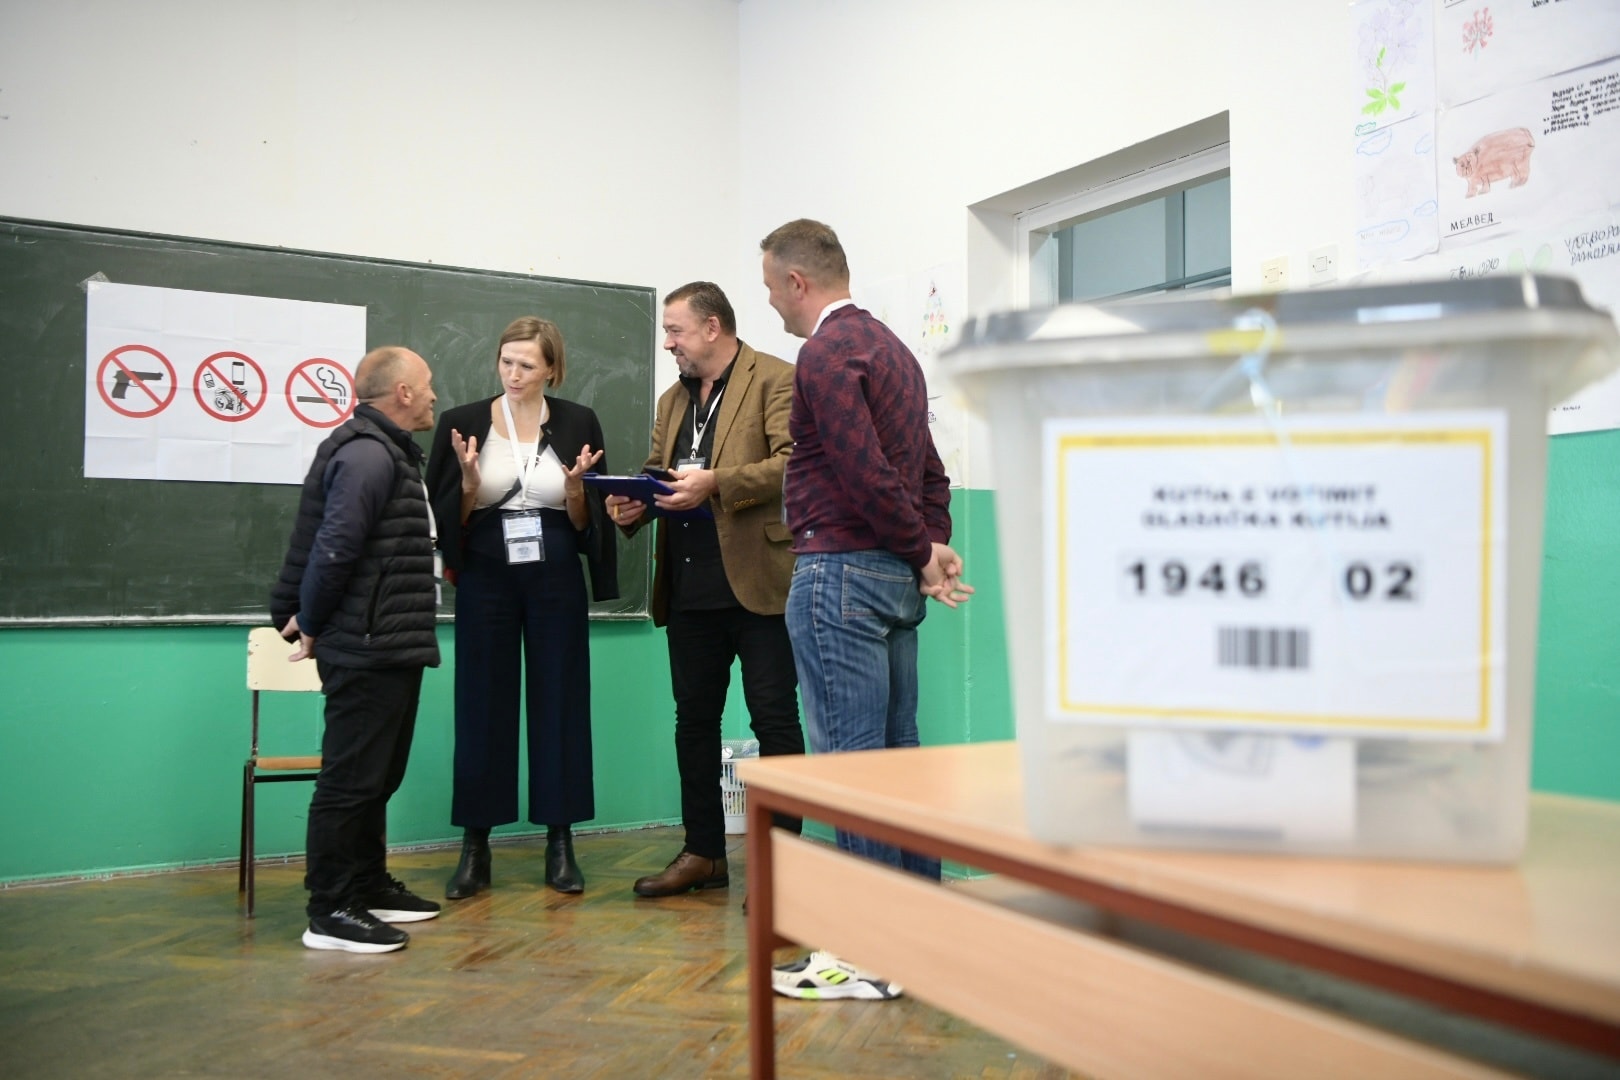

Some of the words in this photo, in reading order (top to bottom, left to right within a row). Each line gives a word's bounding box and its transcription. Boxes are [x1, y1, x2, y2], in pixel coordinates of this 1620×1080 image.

[1154, 486, 1231, 503] KUTIA
[1290, 511, 1391, 530] KUTIJA
[1126, 560, 1268, 597] 1946
[1344, 564, 1417, 601] 02
